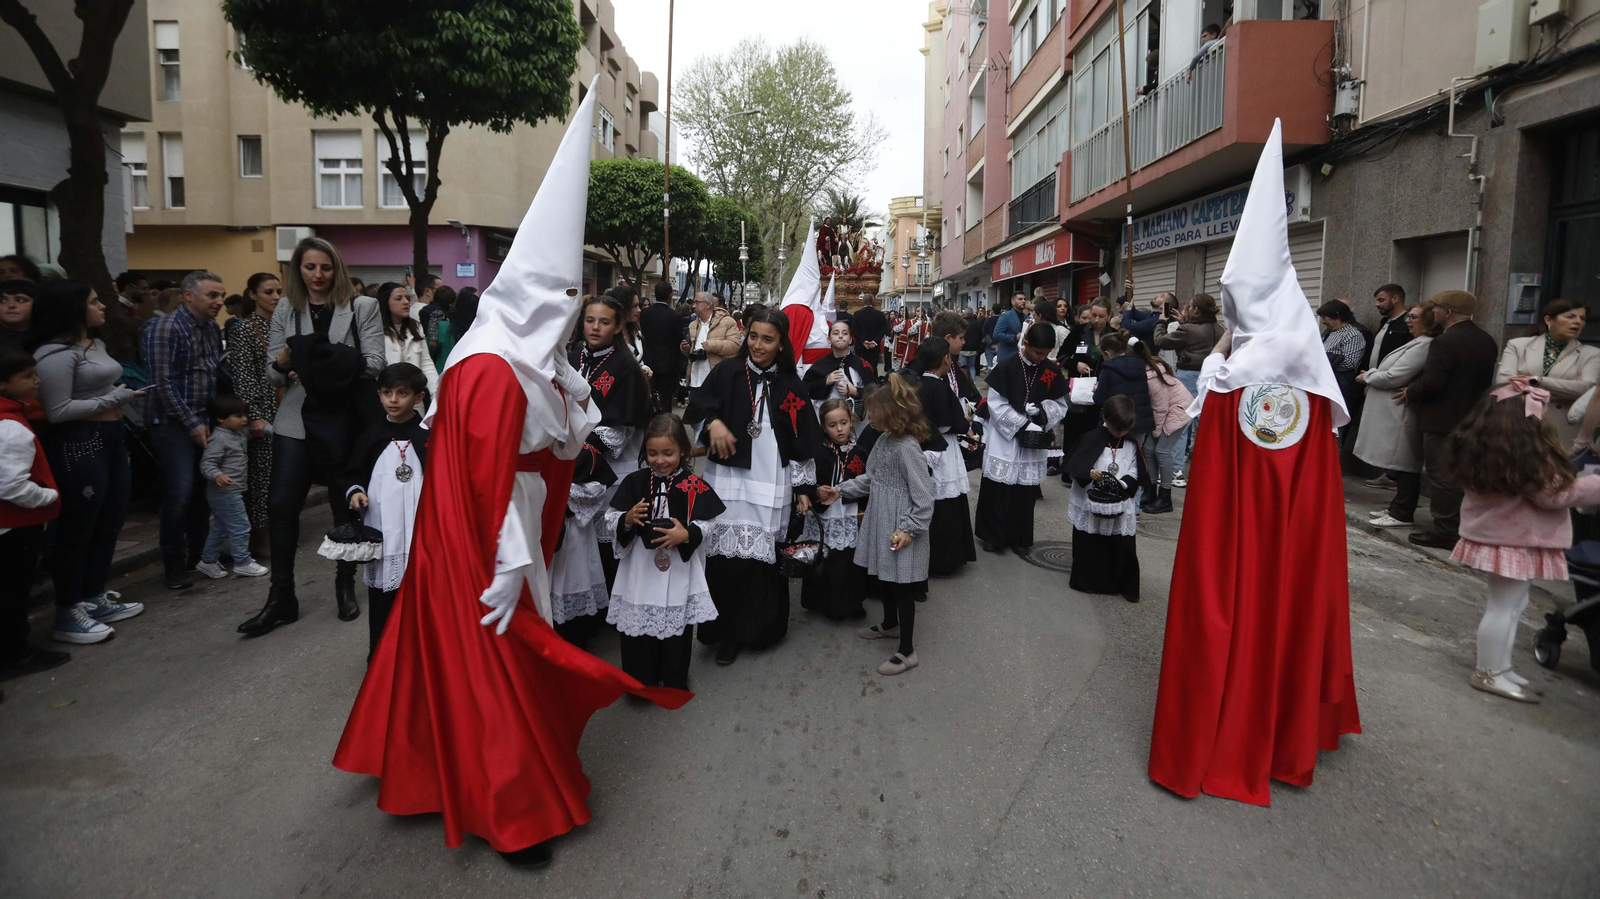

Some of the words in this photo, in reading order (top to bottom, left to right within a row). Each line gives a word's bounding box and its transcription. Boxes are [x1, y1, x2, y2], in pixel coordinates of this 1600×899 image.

[1123, 221, 1140, 244] BR
[1142, 206, 1188, 239] MARIANO
[1191, 187, 1249, 226] CAFETER
[1124, 236, 1170, 255] PSCADOS
[1175, 229, 1202, 246] PARA
